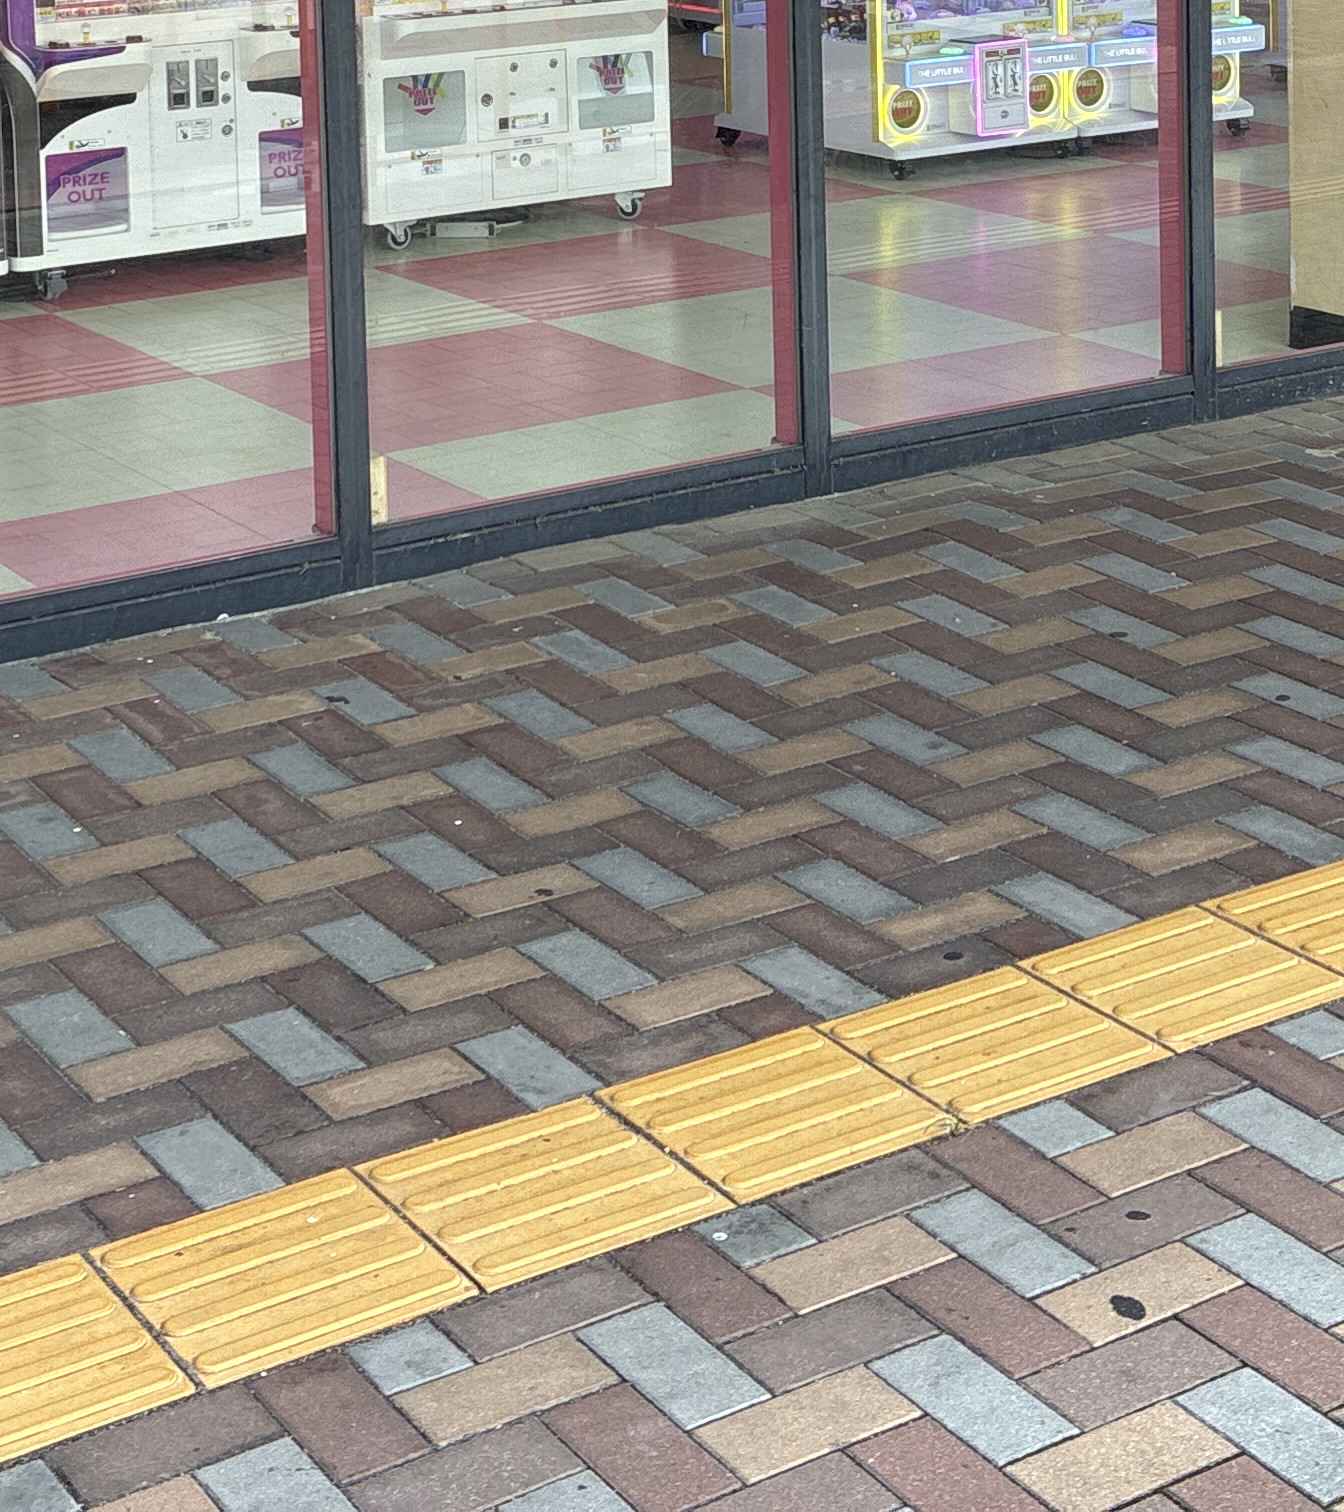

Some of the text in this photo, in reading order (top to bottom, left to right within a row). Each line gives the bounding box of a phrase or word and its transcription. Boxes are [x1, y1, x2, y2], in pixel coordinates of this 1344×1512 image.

[268, 150, 305, 165] PRIZ
[62, 171, 110, 189] PRIZE
[67, 188, 107, 204] OUT
